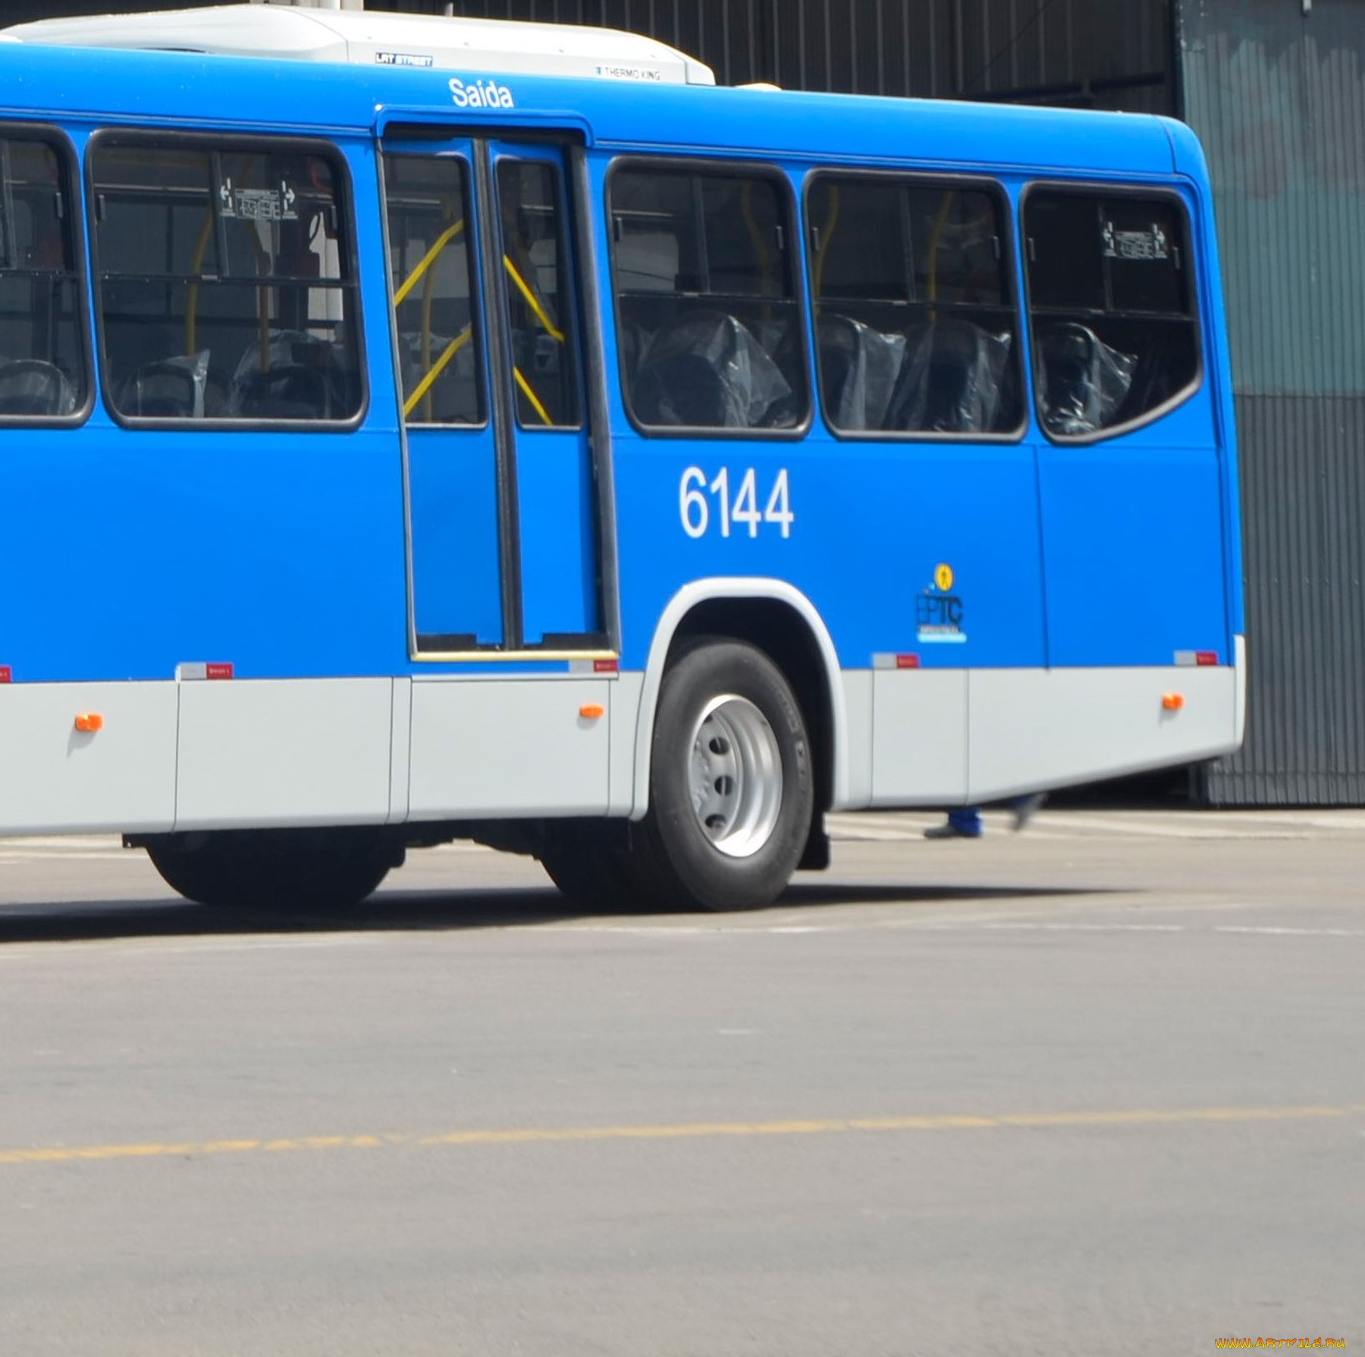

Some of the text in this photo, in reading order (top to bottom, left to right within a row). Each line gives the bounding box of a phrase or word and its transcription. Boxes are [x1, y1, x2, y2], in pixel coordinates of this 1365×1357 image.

[604, 66, 661, 81] THERMO KING
[679, 466, 794, 539] 6144
